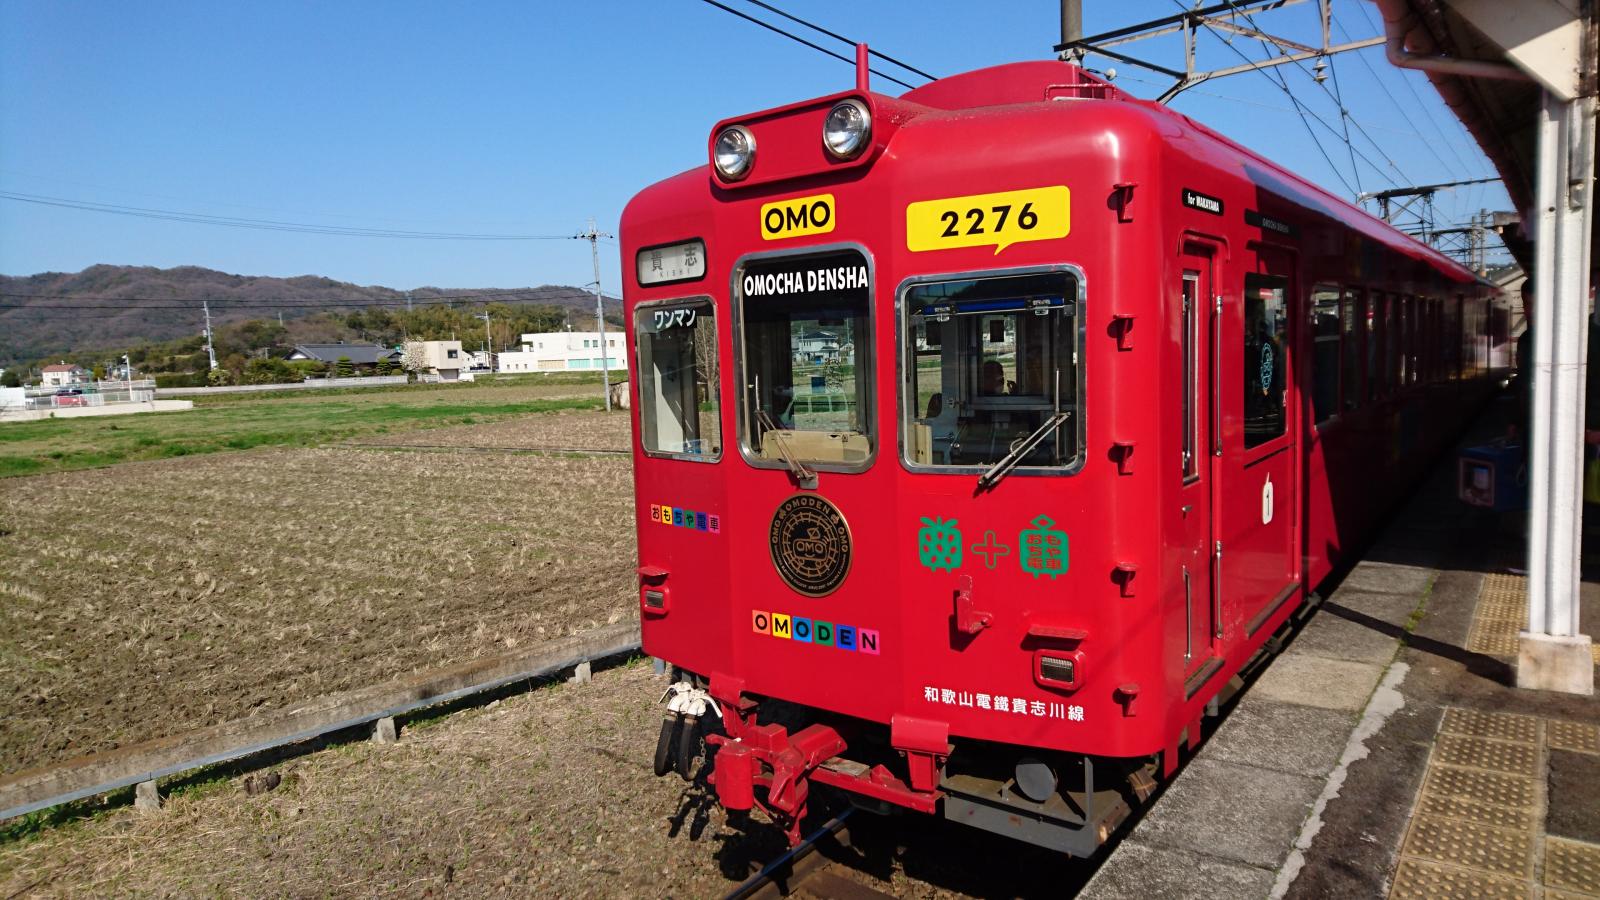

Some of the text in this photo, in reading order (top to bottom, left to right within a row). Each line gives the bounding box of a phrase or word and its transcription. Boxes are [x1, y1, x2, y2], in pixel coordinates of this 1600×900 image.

[765, 201, 830, 233] OMO
[1187, 191, 1220, 213] for WAKAYAMA
[940, 202, 1038, 237] 2276
[651, 243, 698, 272] 貴志
[744, 266, 868, 296] OMOCHA DENSHA
[654, 308, 696, 329] ワンマン
[651, 505, 720, 532] おもちゃ電車
[785, 497, 831, 515] OMODEN
[837, 526, 849, 553] OMO
[796, 541, 824, 554] OMO
[754, 613, 877, 651] OMODEN
[924, 686, 1085, 722] 和歌山電鐵貴志川線
